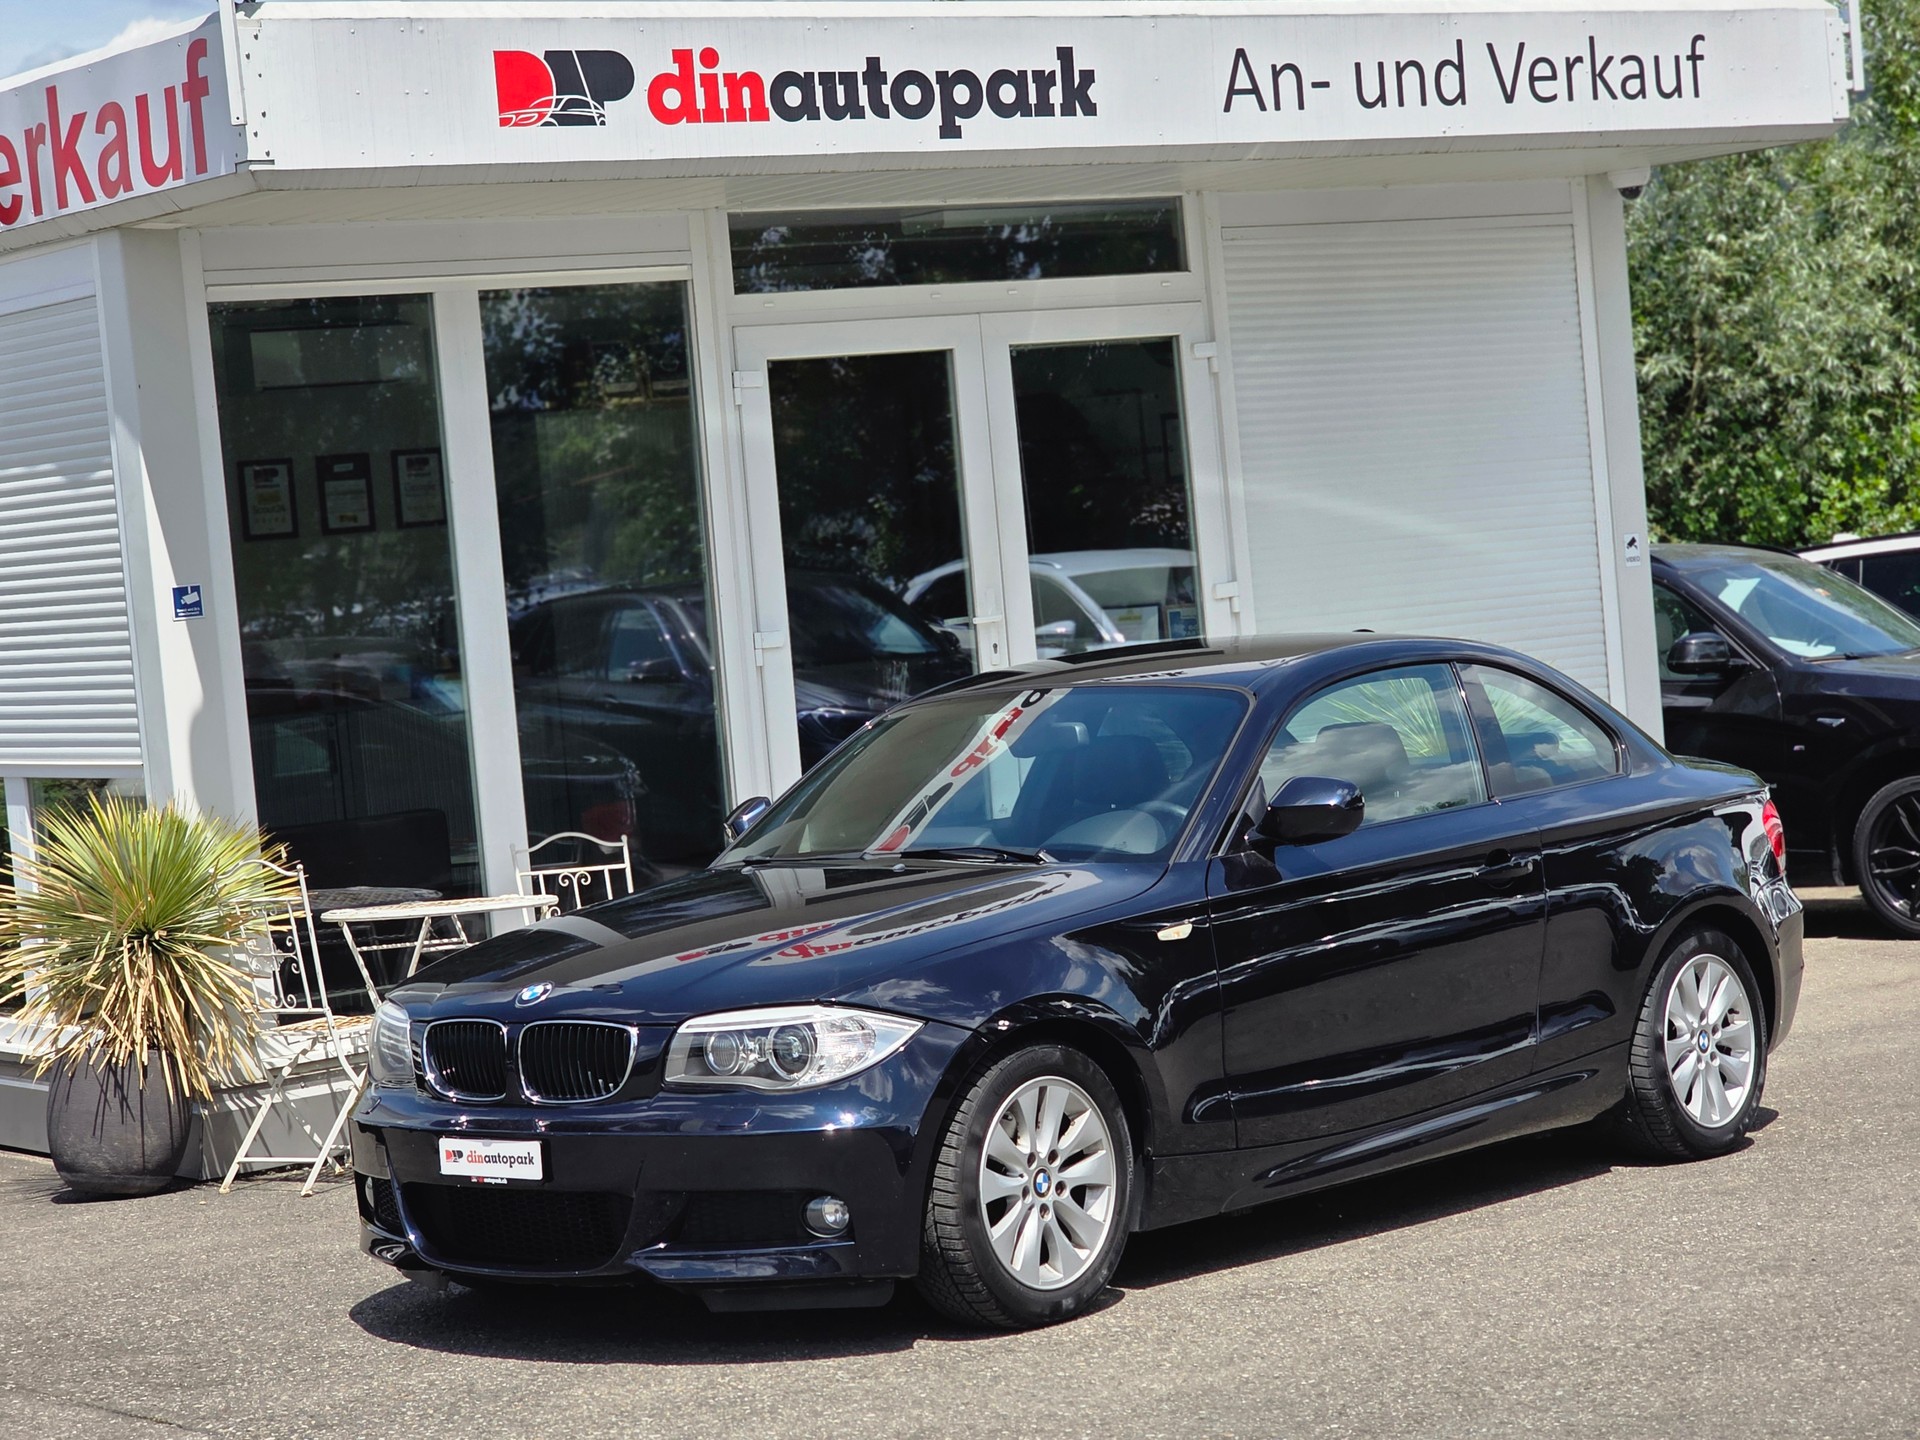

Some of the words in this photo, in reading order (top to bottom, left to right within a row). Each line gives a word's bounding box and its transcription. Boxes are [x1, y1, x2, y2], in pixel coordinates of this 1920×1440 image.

[647, 46, 1098, 140] dinautopark
[1223, 47, 1331, 113] An-
[1354, 38, 1467, 110] und
[1485, 34, 1706, 104] Verkauf
[466, 1150, 535, 1168] dinautopark
